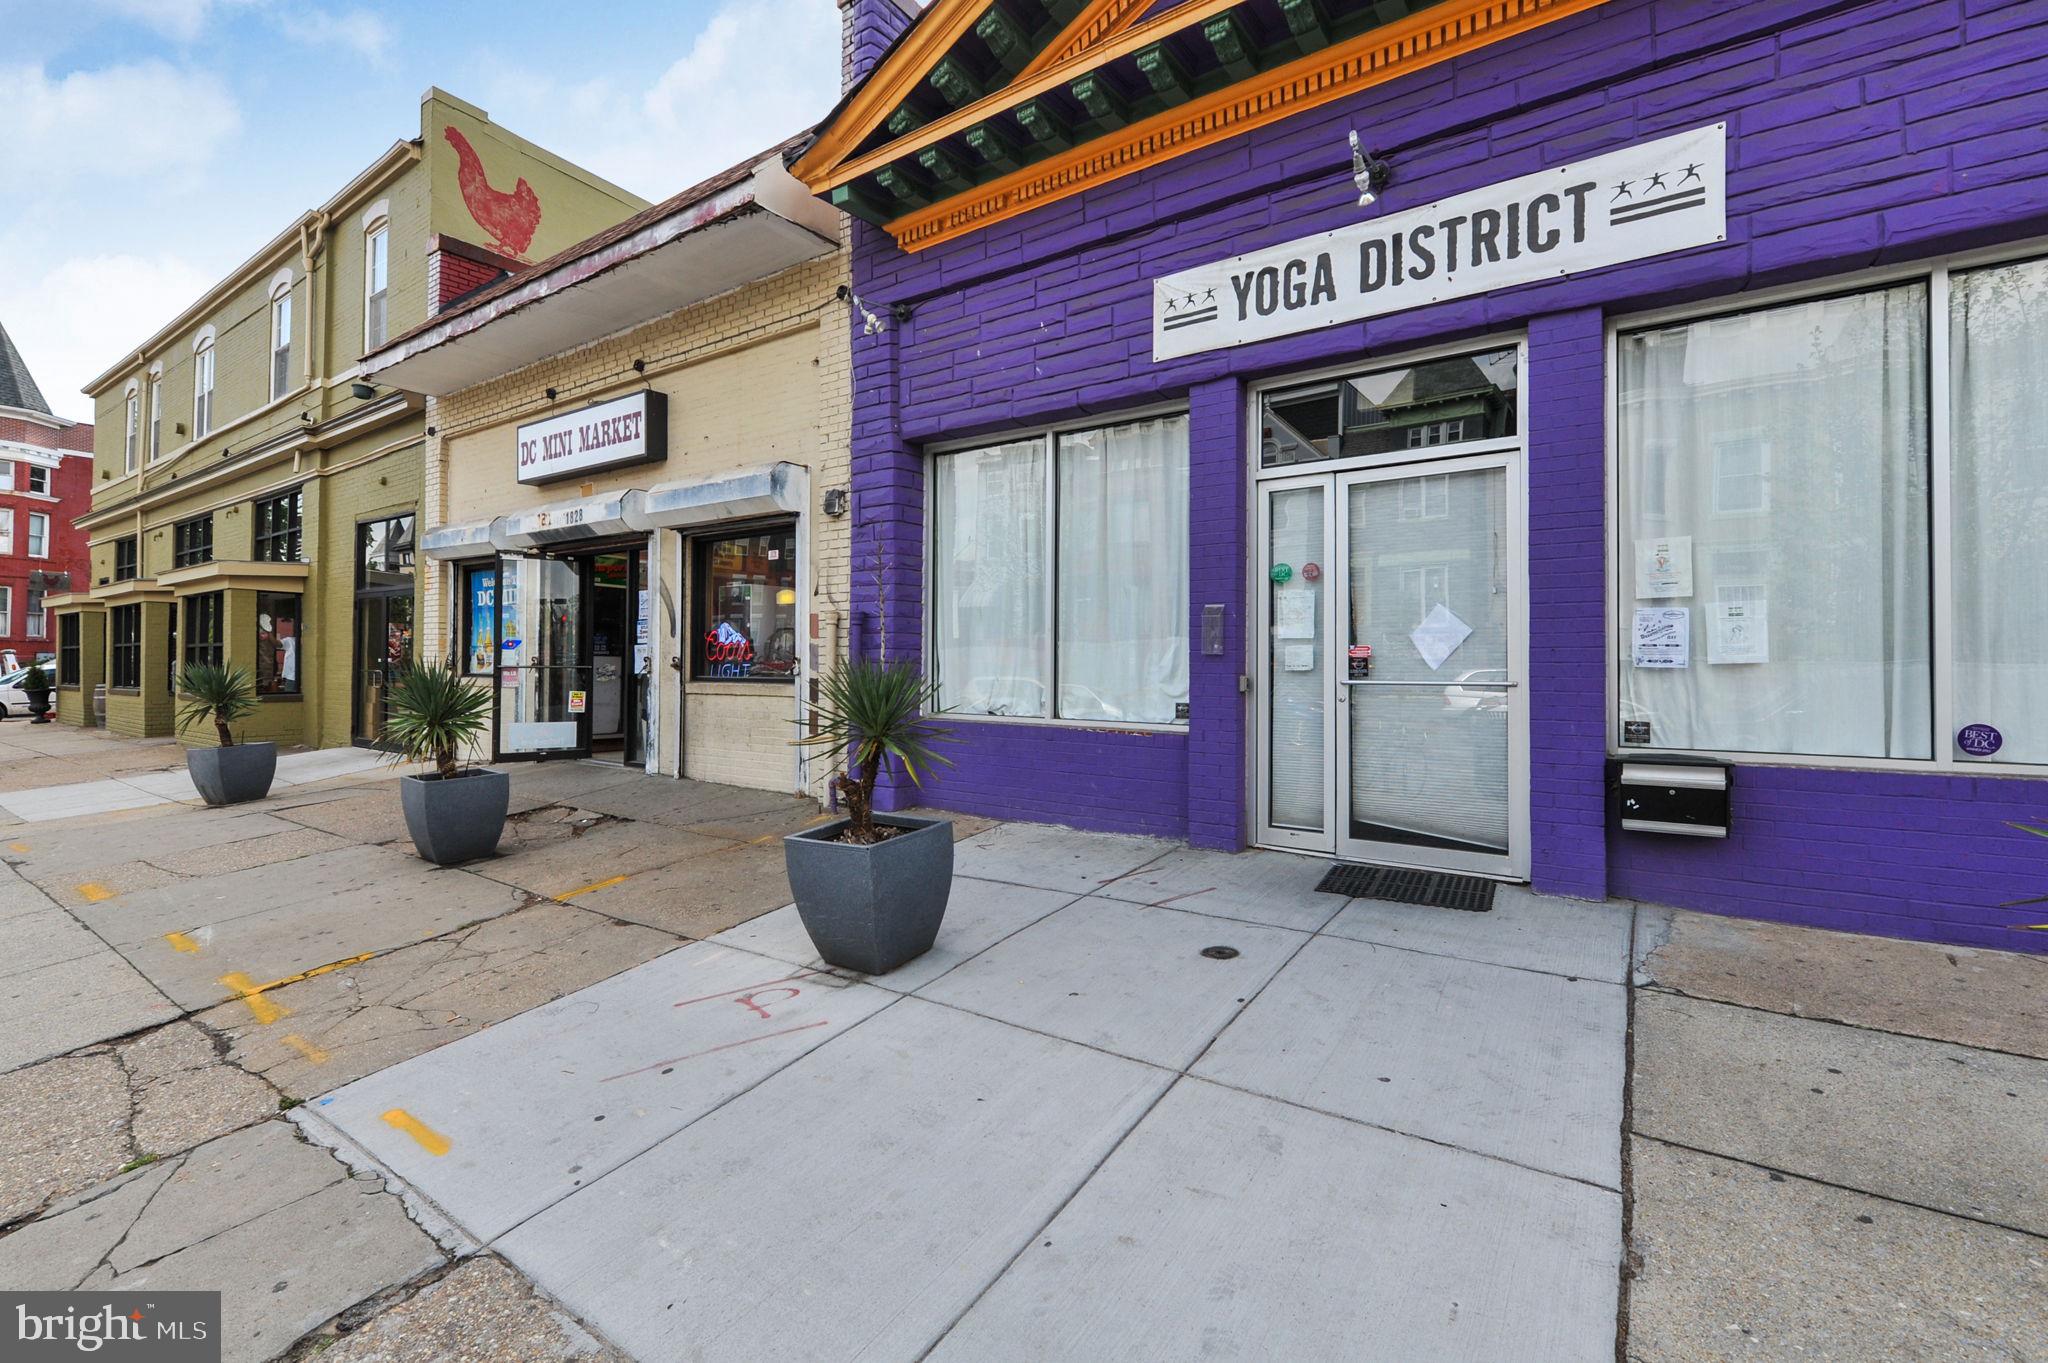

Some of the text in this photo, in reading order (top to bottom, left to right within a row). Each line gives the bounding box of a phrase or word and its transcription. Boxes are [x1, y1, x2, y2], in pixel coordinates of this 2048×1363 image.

[1231, 181, 1597, 321] YOGA DISTRICT
[520, 410, 642, 467] DC MINI MARKET
[566, 508, 583, 525] 1828
[704, 628, 754, 661] Coors
[710, 663, 751, 678] LIGHT
[1964, 730, 1998, 740] BEST
[1974, 738, 1997, 749] DC
